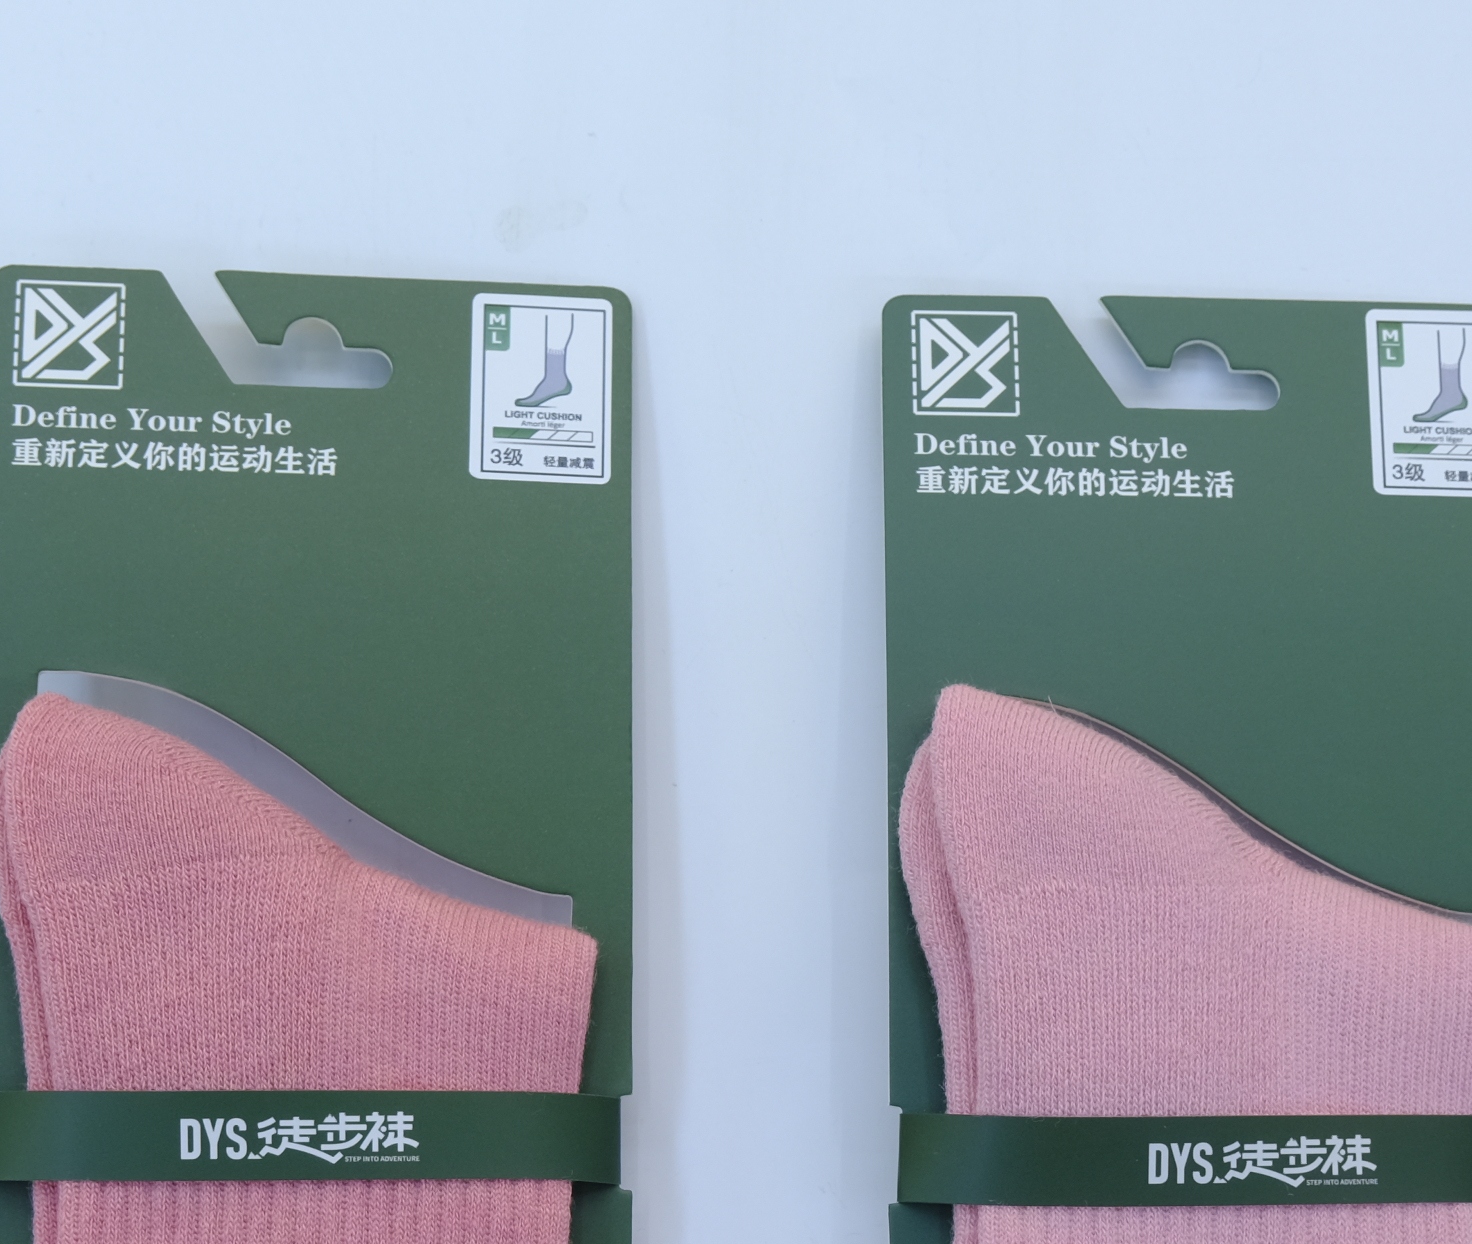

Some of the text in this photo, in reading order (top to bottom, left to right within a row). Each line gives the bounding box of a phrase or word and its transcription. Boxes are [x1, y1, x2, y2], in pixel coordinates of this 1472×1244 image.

[489, 313, 506, 325] M
[492, 332, 502, 344] L
[1382, 330, 1399, 342] M
[1386, 348, 1396, 360] L
[12, 404, 292, 436] Define Your Style
[505, 411, 582, 421] LIGHT CUSHION
[1403, 426, 1432, 434] LIGHT
[914, 433, 1188, 461] Define Your Style
[11, 439, 338, 477] 重新定义你的运动生活
[490, 448, 595, 469] 3级 轻量减震
[916, 466, 1235, 499] 重新定义你的运动生活
[1392, 463, 1425, 482] 3级
[257, 1111, 419, 1164] 徒步袜
[1223, 1135, 1377, 1187] 徒步袜
